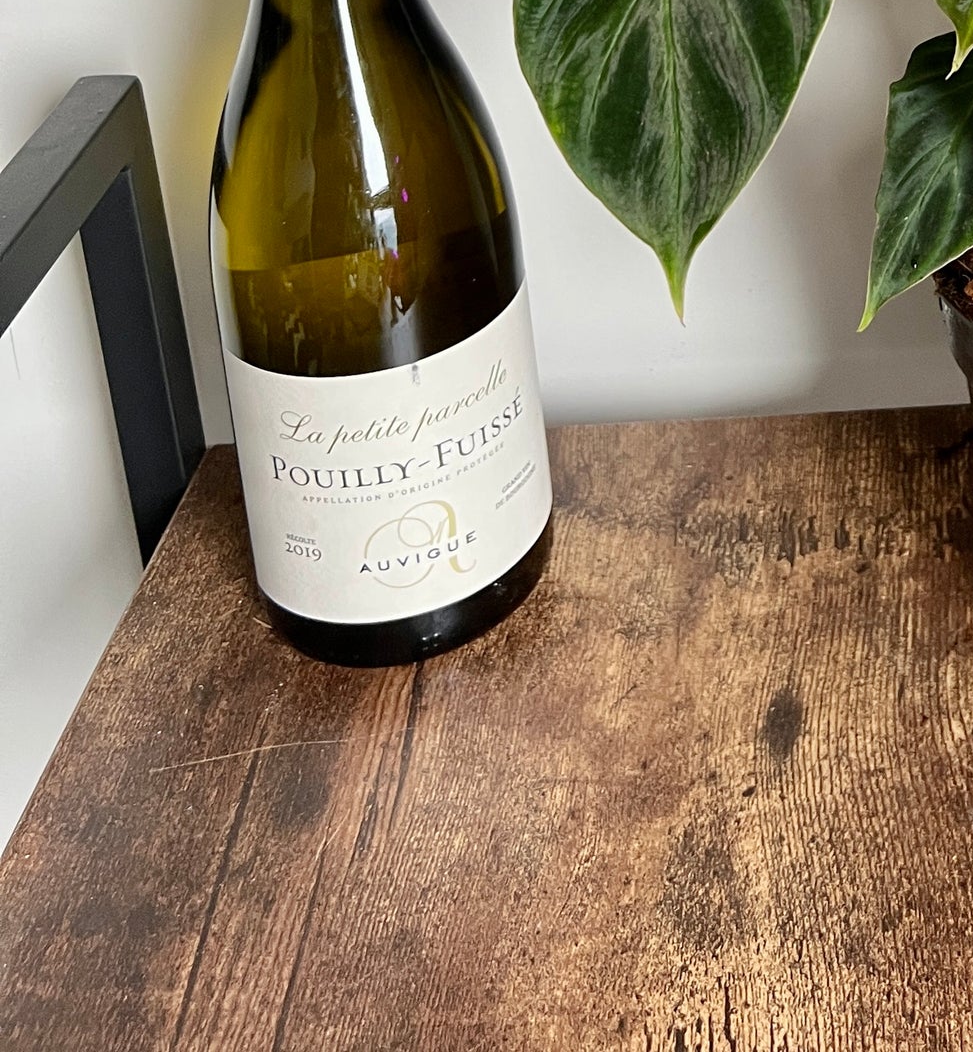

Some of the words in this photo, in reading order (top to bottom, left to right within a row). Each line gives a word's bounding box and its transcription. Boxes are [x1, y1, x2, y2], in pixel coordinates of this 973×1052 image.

[279, 410, 325, 445] La
[326, 416, 410, 455] petite
[411, 358, 507, 442] parcelle
[269, 386, 524, 490] POUILLY-FUISSÉ
[302, 493, 382, 505] APPELLATION
[388, 474, 451, 499] D'ORIGINE
[285, 541, 322, 562] 2019
[359, 530, 477, 574] AUVIGUE
